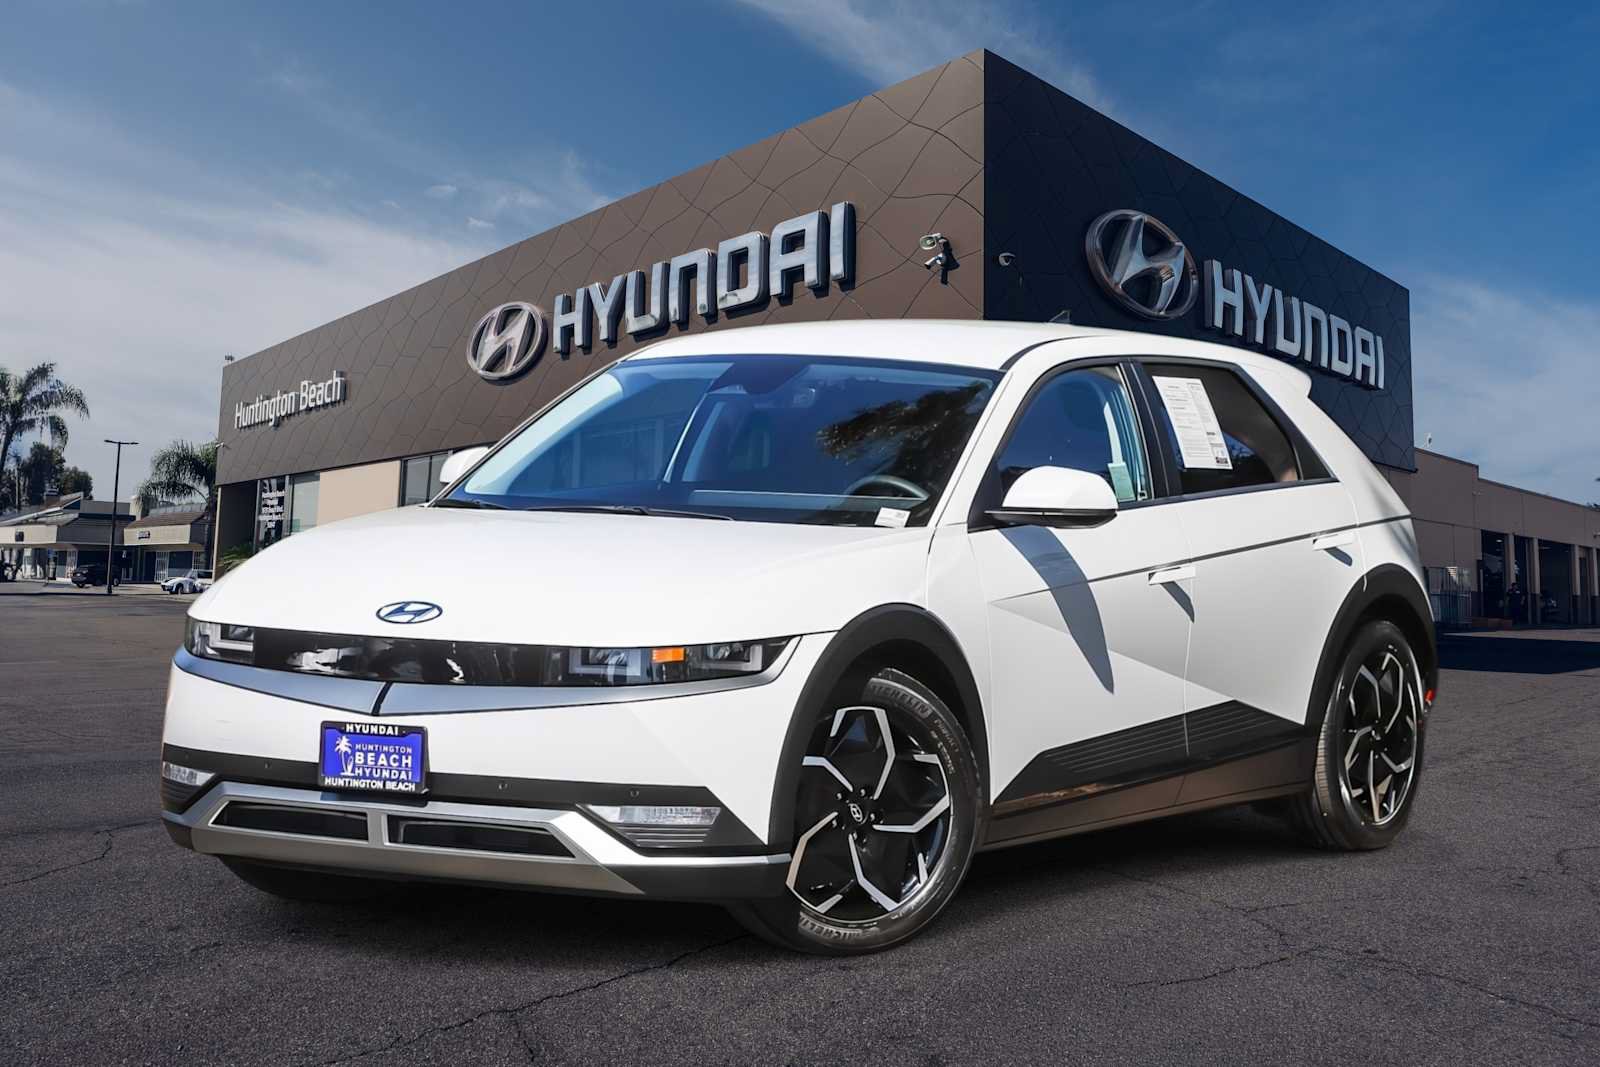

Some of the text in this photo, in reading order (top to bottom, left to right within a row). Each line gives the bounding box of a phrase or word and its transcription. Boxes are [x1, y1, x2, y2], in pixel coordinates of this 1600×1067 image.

[552, 201, 852, 353] HYUNDAI
[1206, 259, 1385, 389] HYUNDAI
[234, 369, 343, 429] Huntington Beach
[345, 723, 399, 736] HYUNDAI
[355, 743, 412, 753] HUNTINGTON
[355, 752, 412, 768] BEACH
[354, 767, 412, 780] HYUNDAI
[324, 777, 416, 792] HUNTINGTON BEACH
